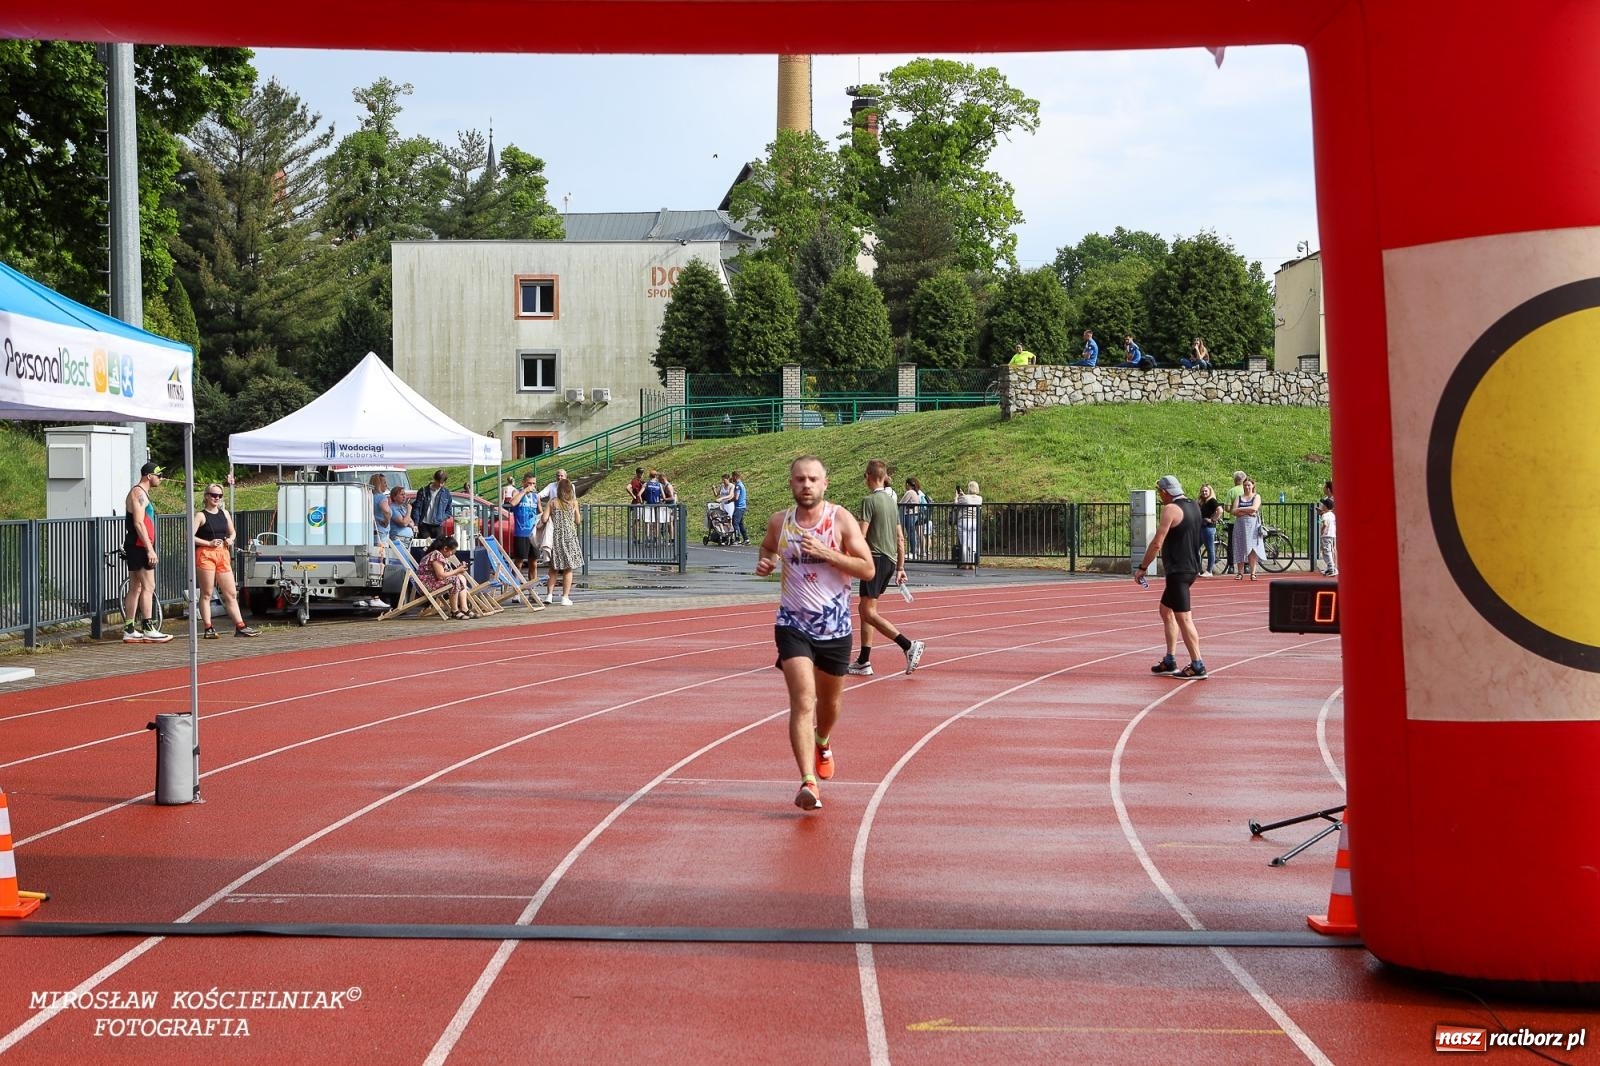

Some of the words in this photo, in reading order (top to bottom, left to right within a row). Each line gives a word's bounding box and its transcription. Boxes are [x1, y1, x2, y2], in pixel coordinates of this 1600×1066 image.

[651, 266, 683, 288] DO
[4, 337, 91, 388] PersonalBest
[339, 443, 385, 453] Wodociągi
[1314, 591, 1337, 623] 0
